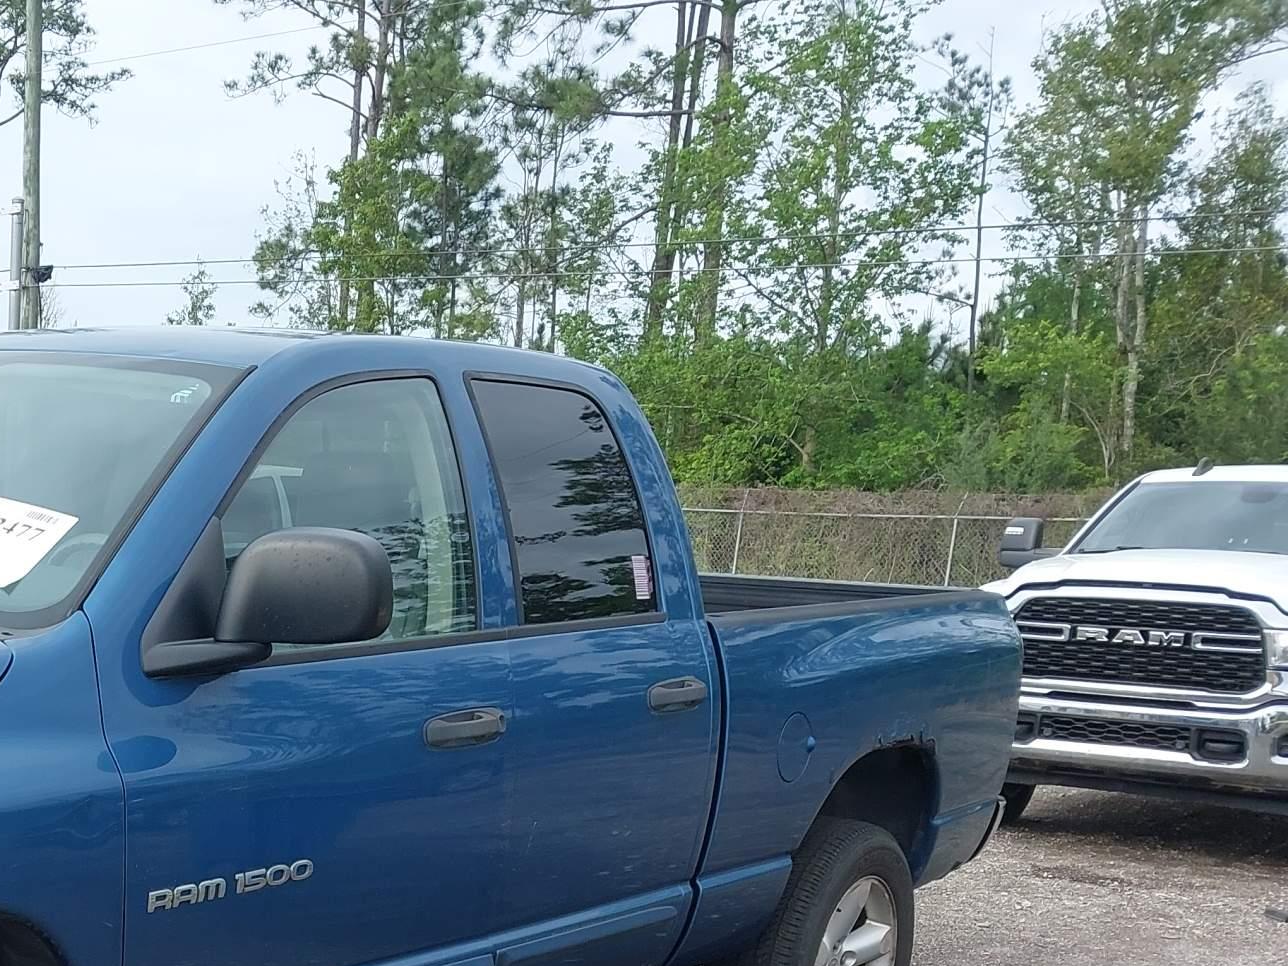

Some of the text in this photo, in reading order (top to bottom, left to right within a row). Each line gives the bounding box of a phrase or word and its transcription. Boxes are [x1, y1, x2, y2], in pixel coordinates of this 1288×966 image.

[1076, 626, 1185, 647] RAM
[147, 859, 314, 913] RAM 1500
